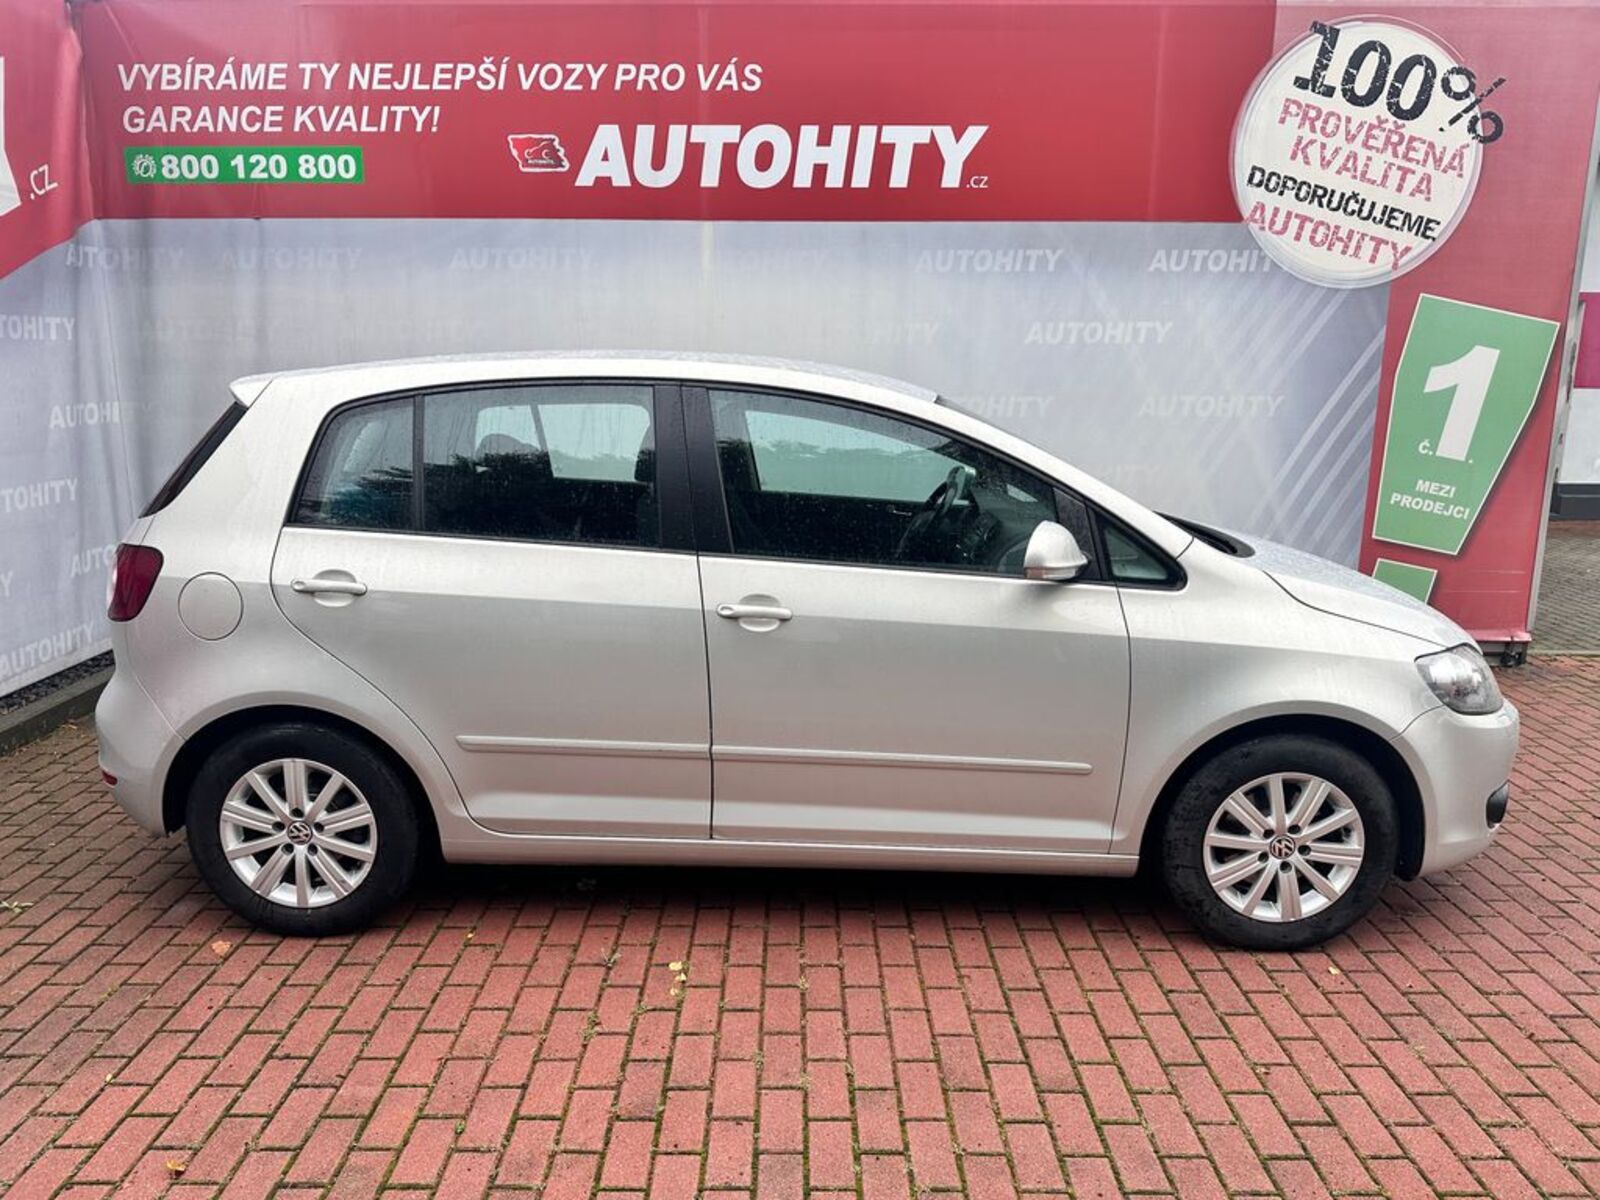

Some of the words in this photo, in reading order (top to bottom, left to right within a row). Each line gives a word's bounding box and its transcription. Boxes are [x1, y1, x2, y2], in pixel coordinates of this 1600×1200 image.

[117, 57, 288, 91] VYBÍRÁME
[300, 63, 339, 91] TY
[347, 56, 511, 91] NEJLEPŠÍ
[518, 63, 607, 91] VOZY
[614, 63, 686, 91] PRO
[697, 57, 763, 92] VÁS
[1294, 20, 1506, 145] 100%
[122, 105, 284, 134] GARANCE
[294, 105, 440, 134] KVALITY!
[1277, 98, 1470, 178] PROVĚŘENÁ
[161, 154, 220, 179] 800
[230, 154, 288, 179] 120
[298, 154, 357, 179] 800
[1290, 134, 1434, 202] KVALITA
[1246, 165, 1441, 242] DOPORUČUJEME
[1244, 201, 1413, 272] AUTOHITY
[449, 247, 594, 271] AUTOHITY
[915, 248, 1064, 273] AUTOHITY
[1149, 249, 1280, 273] AUTOHIT
[1024, 321, 1174, 345] AUTOHITY
[1136, 395, 1285, 418] AUTOHITY
[1415, 479, 1456, 499] MEZI
[1389, 492, 1471, 520] PRODEJCI
